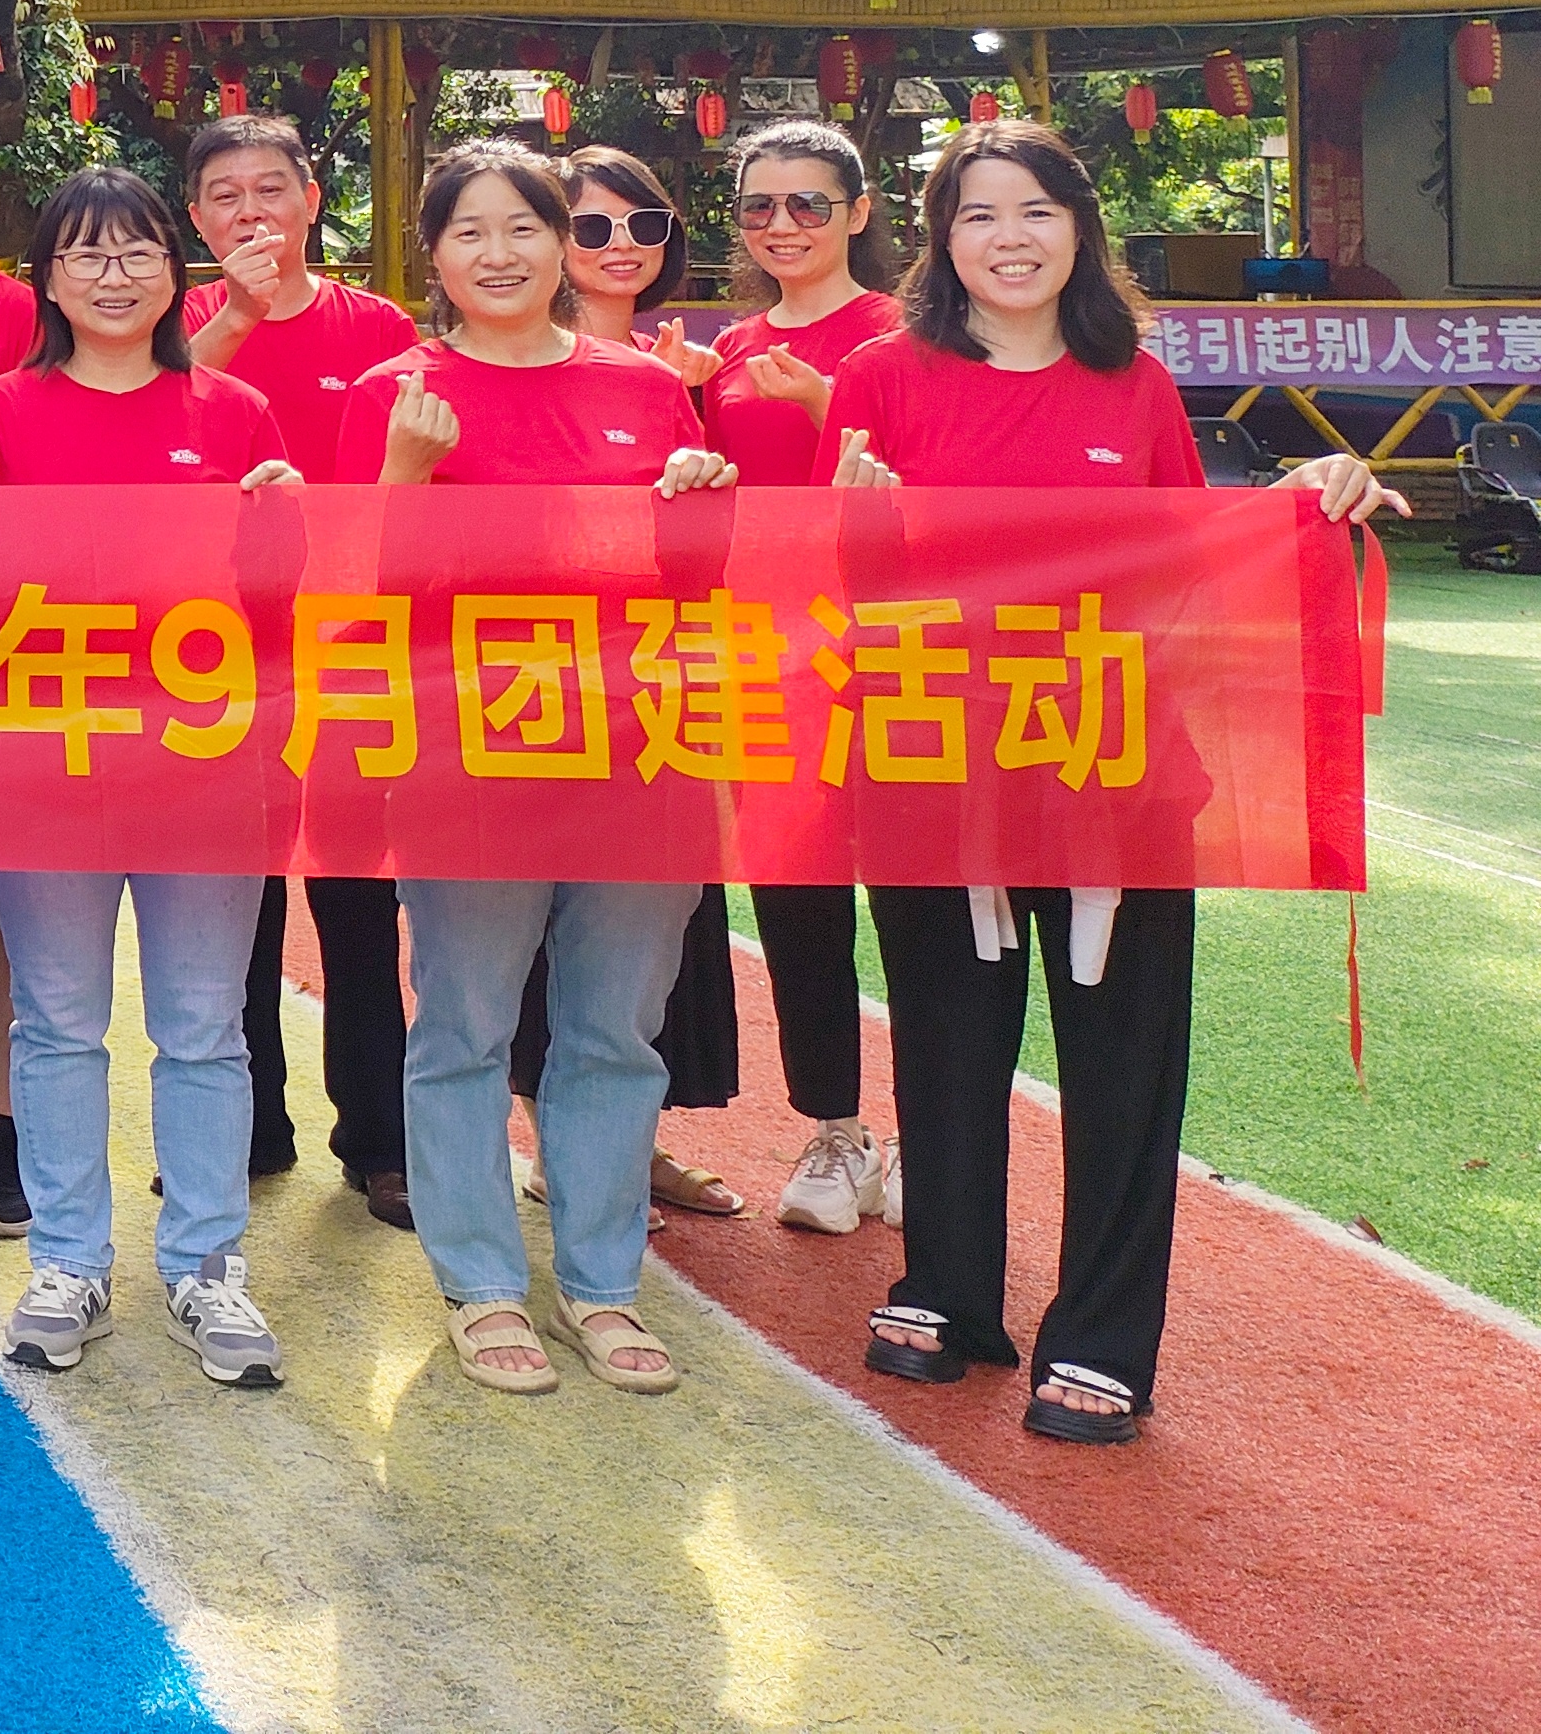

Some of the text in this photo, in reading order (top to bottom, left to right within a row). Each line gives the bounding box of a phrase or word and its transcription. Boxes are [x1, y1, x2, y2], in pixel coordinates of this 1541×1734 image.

[1140, 315, 1541, 375] 能引起别人注意
